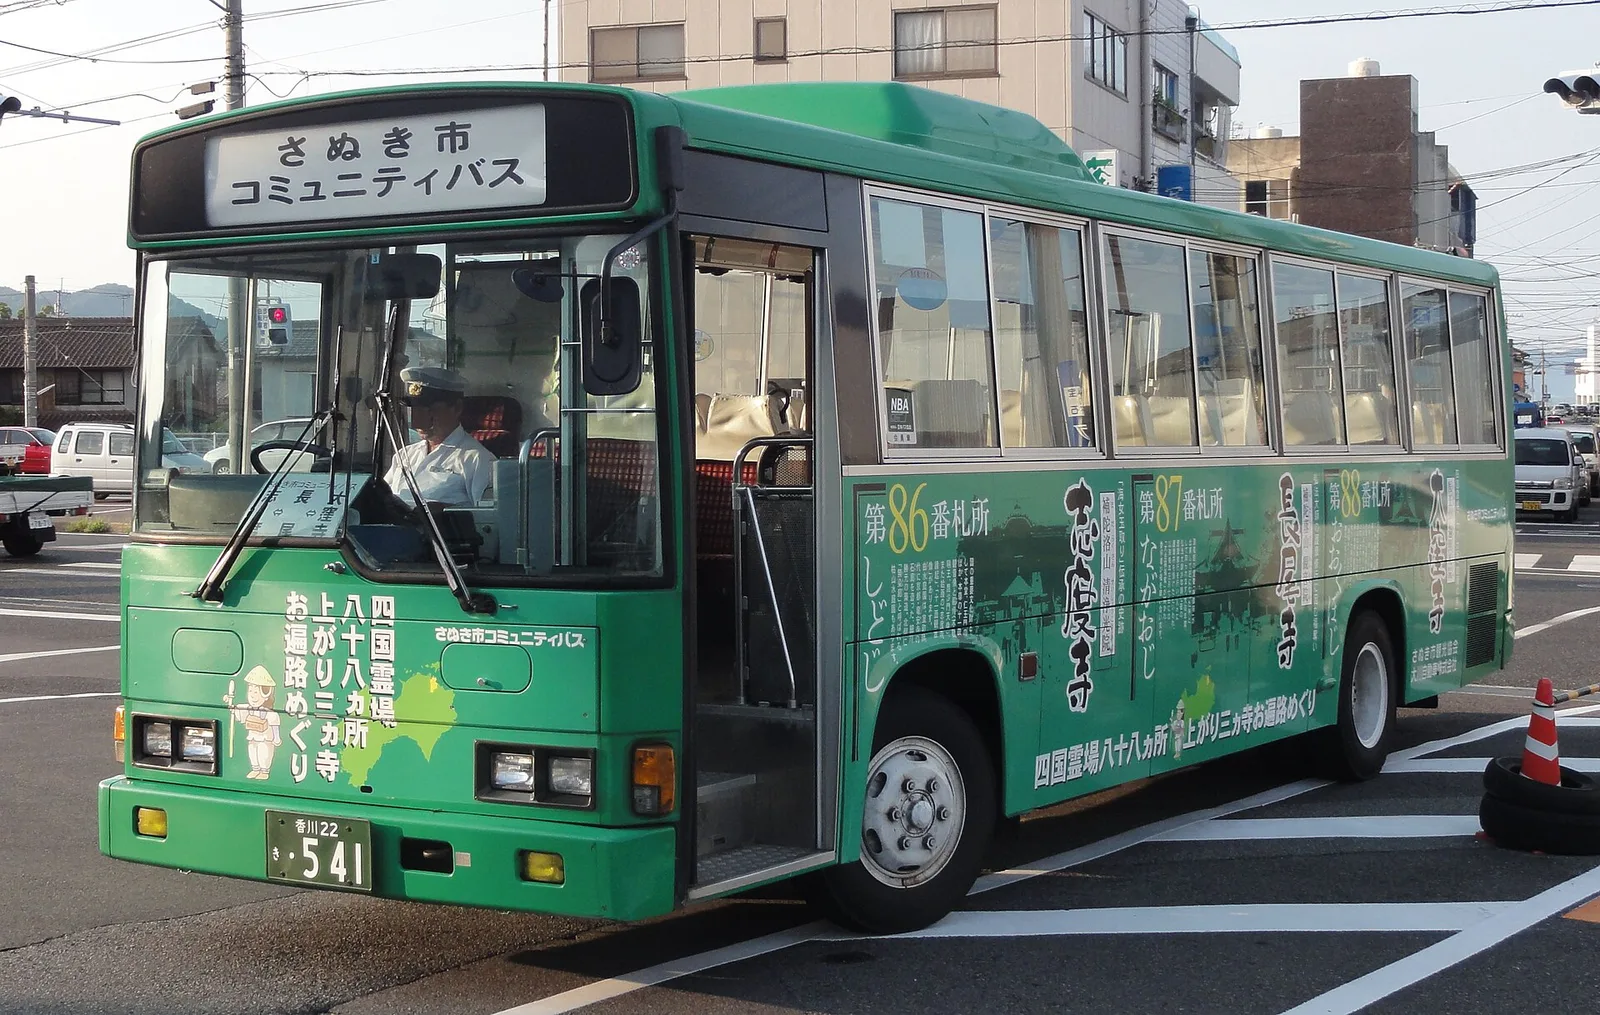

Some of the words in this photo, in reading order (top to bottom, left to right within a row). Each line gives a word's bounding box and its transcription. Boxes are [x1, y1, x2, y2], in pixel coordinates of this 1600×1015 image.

[277, 121, 473, 168] さぬき市
[231, 157, 526, 205] コミュニティバス
[891, 397, 909, 411] NBA
[864, 482, 990, 554] 第86番札所
[1140, 474, 1223, 533] 第87番札所
[1329, 469, 1391, 518] 第88番札所
[1061, 477, 1099, 713] 志度寺
[1275, 471, 1301, 670] 長尾寺
[434, 625, 586, 649] さぬき市コミュニティバス
[863, 556, 887, 693] しどじ
[1138, 533, 1157, 681] ながおじ
[284, 590, 312, 784] お遍路めぐり
[369, 594, 398, 729] 四国霊場
[272, 846, 280, 861] き
